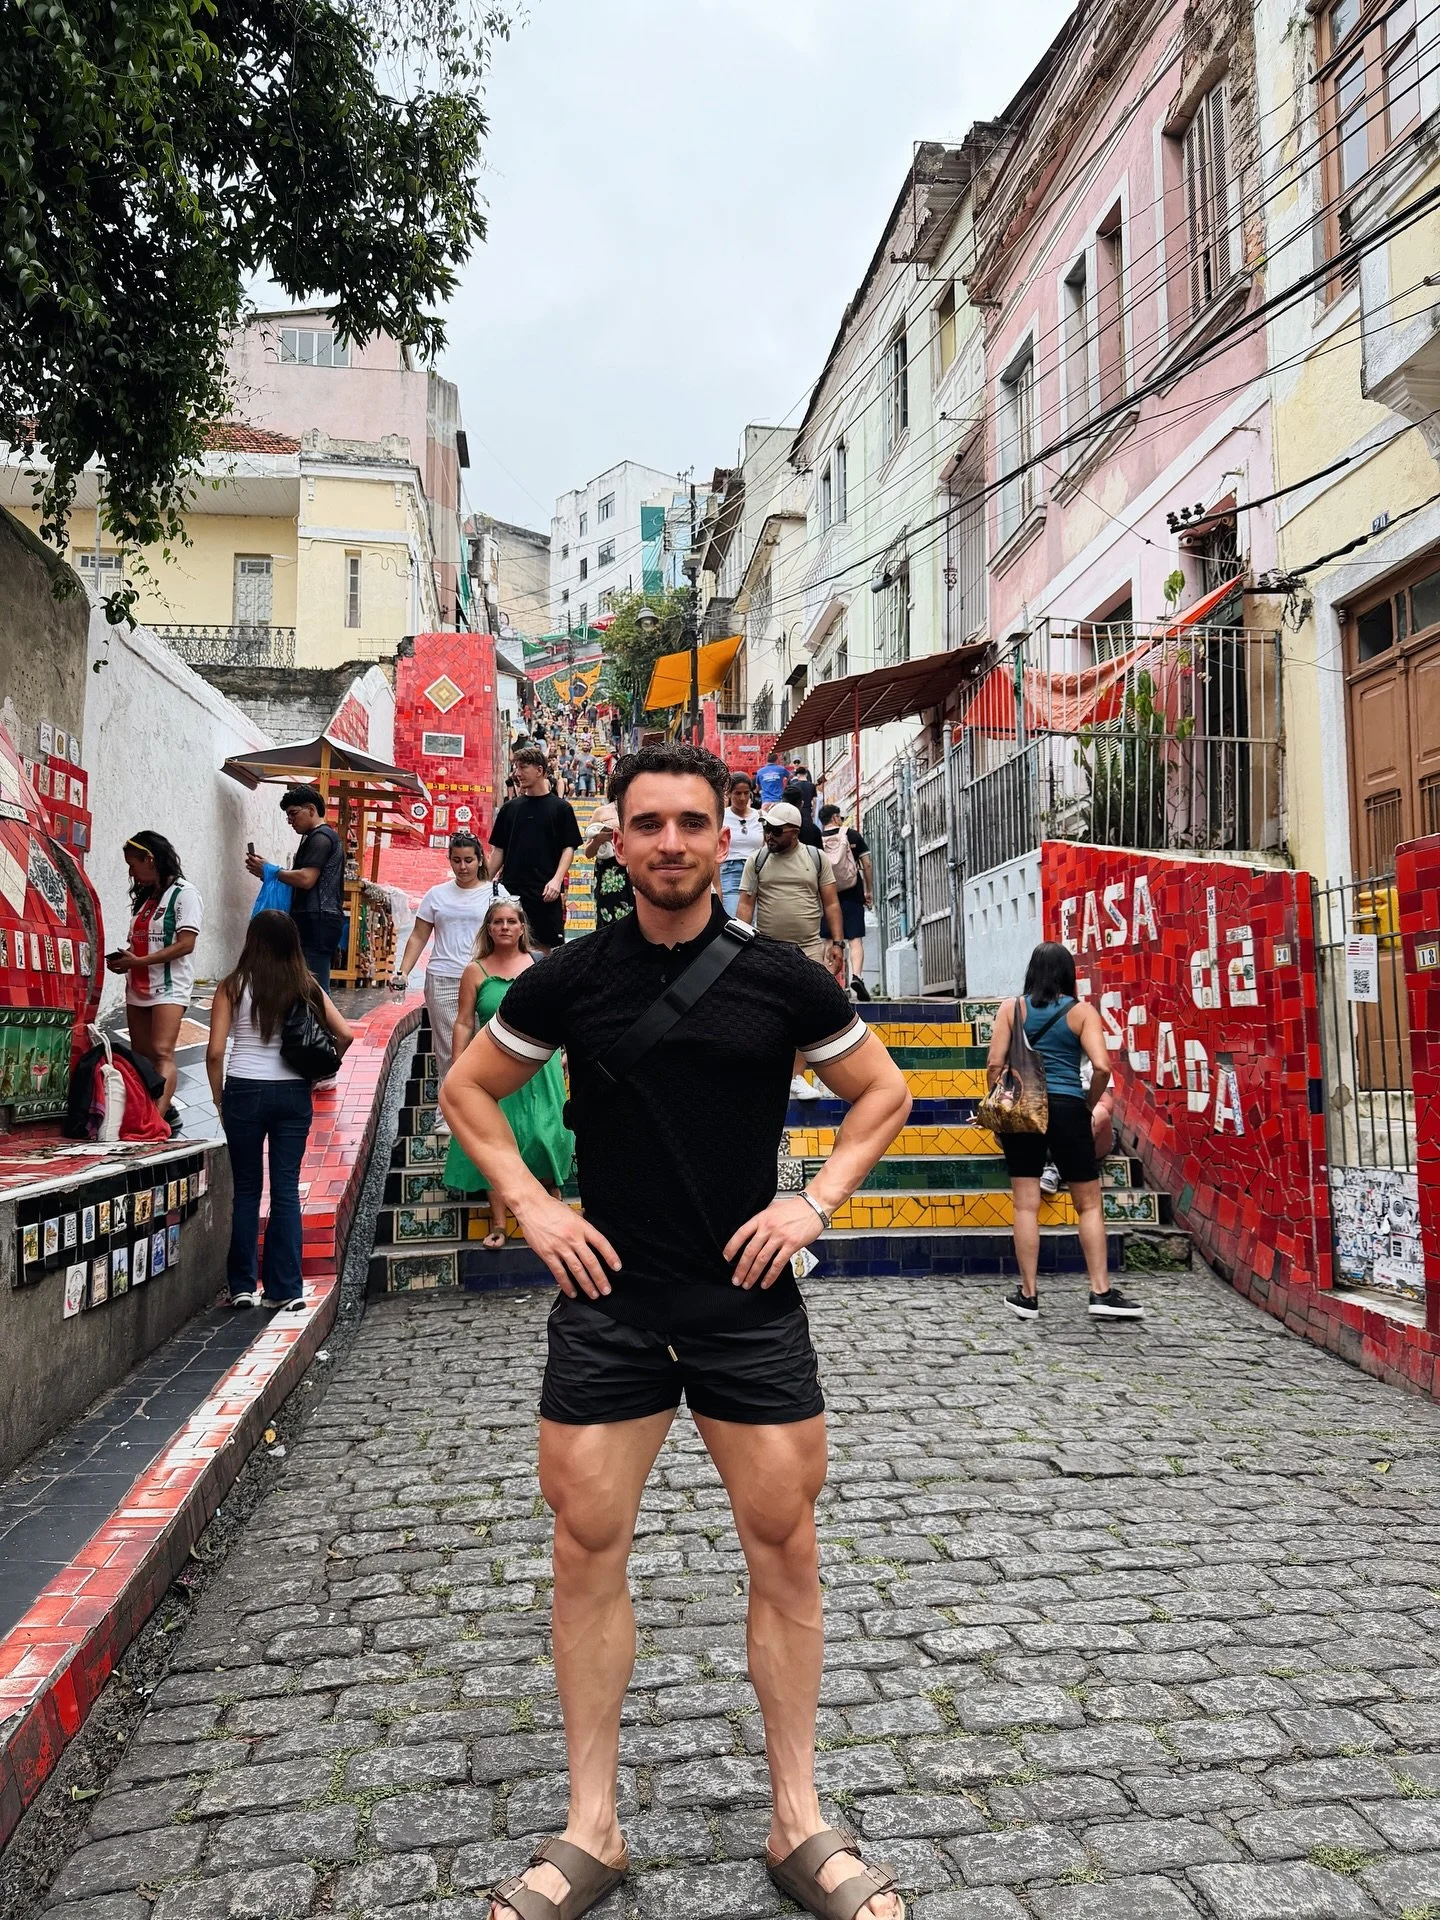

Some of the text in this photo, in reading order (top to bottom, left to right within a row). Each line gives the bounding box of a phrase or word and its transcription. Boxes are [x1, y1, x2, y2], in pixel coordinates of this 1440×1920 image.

[1374, 515, 1386, 531] 20
[944, 573, 957, 585] 53
[1061, 875, 1259, 1010] CASA da
[1421, 949, 1435, 965] 18
